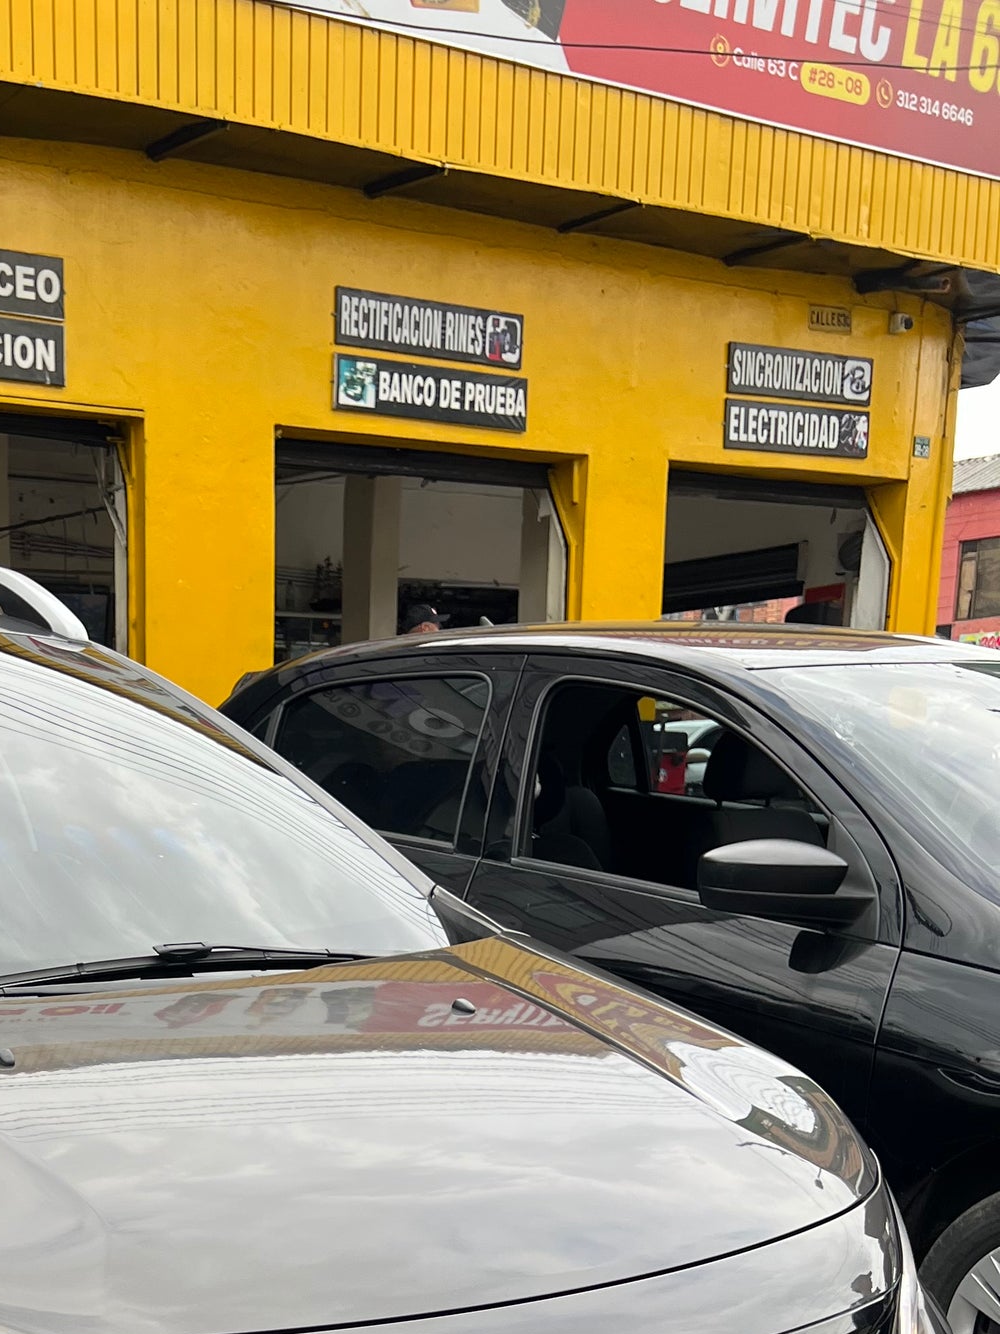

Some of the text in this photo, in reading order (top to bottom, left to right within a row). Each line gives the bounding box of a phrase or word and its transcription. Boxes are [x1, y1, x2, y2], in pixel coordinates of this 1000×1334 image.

[732, 47, 766, 73] Calle
[896, 89, 917, 111] 312
[919, 95, 940, 118] 314
[941, 102, 974, 126] 6646
[340, 294, 484, 356] RECTIFICACION RINES
[378, 370, 526, 418] BANCO DE PRUEBA
[732, 348, 843, 396] SINCRONIZACION
[729, 405, 840, 449] ELECTRICIDAD
